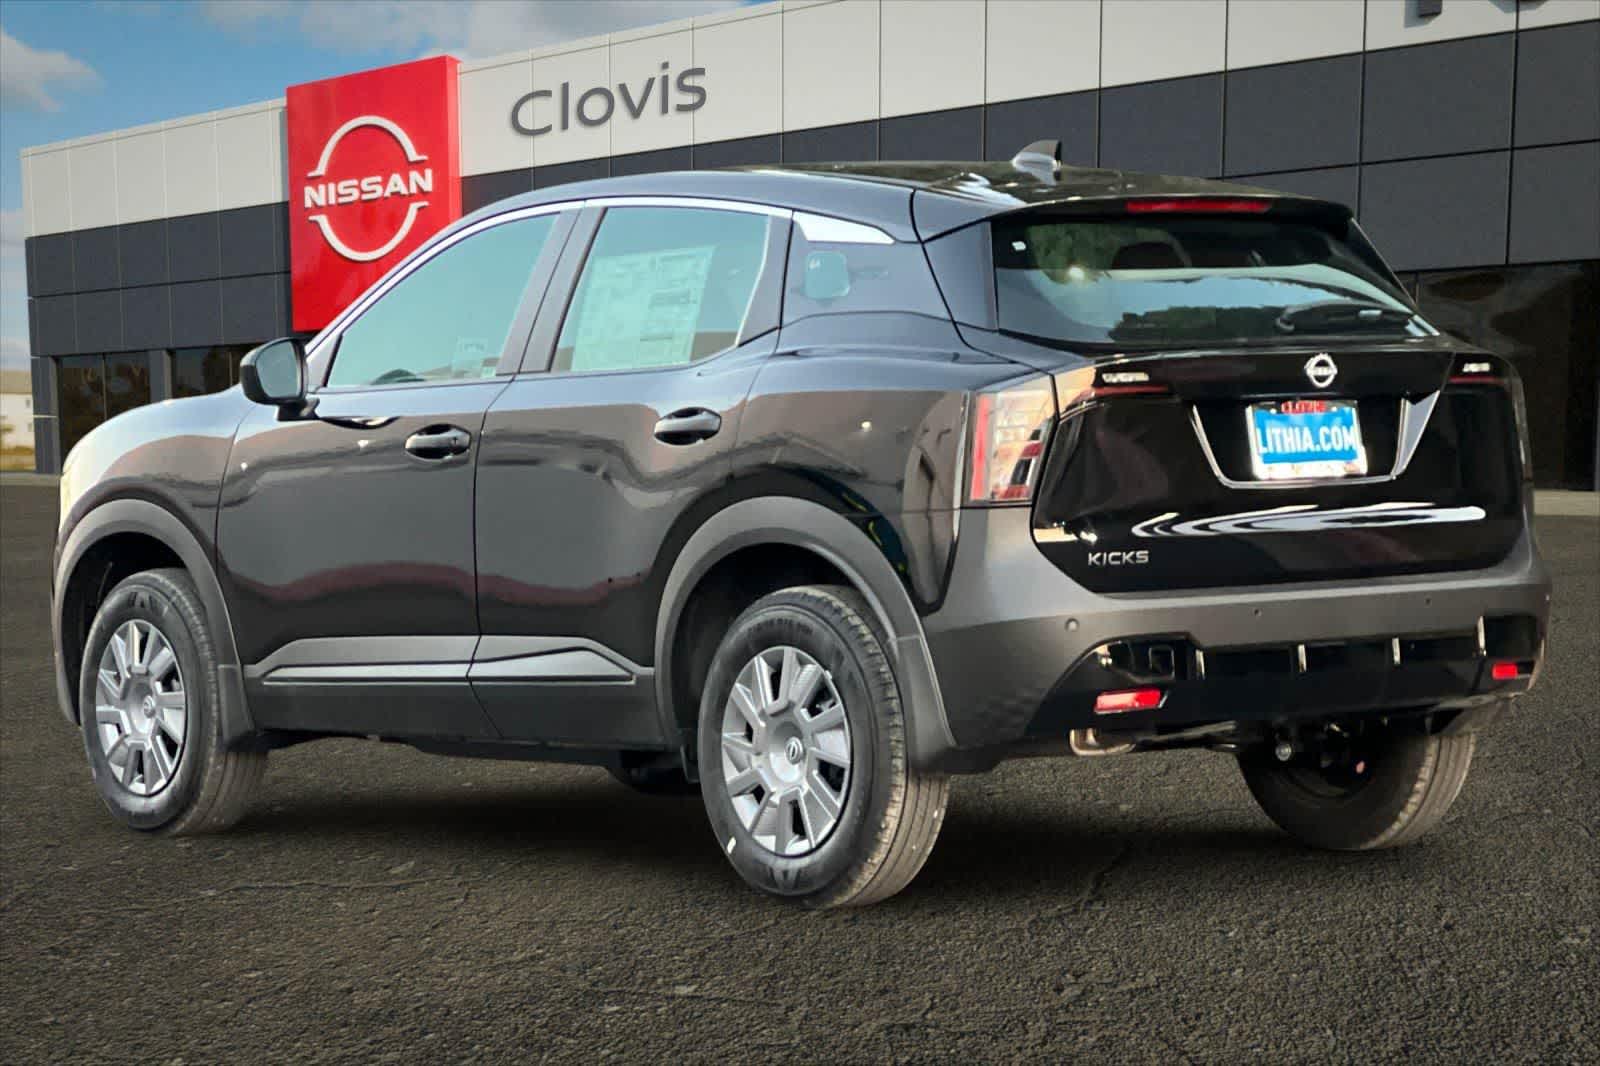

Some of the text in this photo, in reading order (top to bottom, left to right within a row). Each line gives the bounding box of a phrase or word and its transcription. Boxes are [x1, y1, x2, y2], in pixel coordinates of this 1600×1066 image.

[511, 61, 707, 137] Clovis
[303, 168, 433, 209] NISSAN
[1256, 426, 1356, 454] LITHIA.COM
[1087, 549, 1150, 567] KICKS
